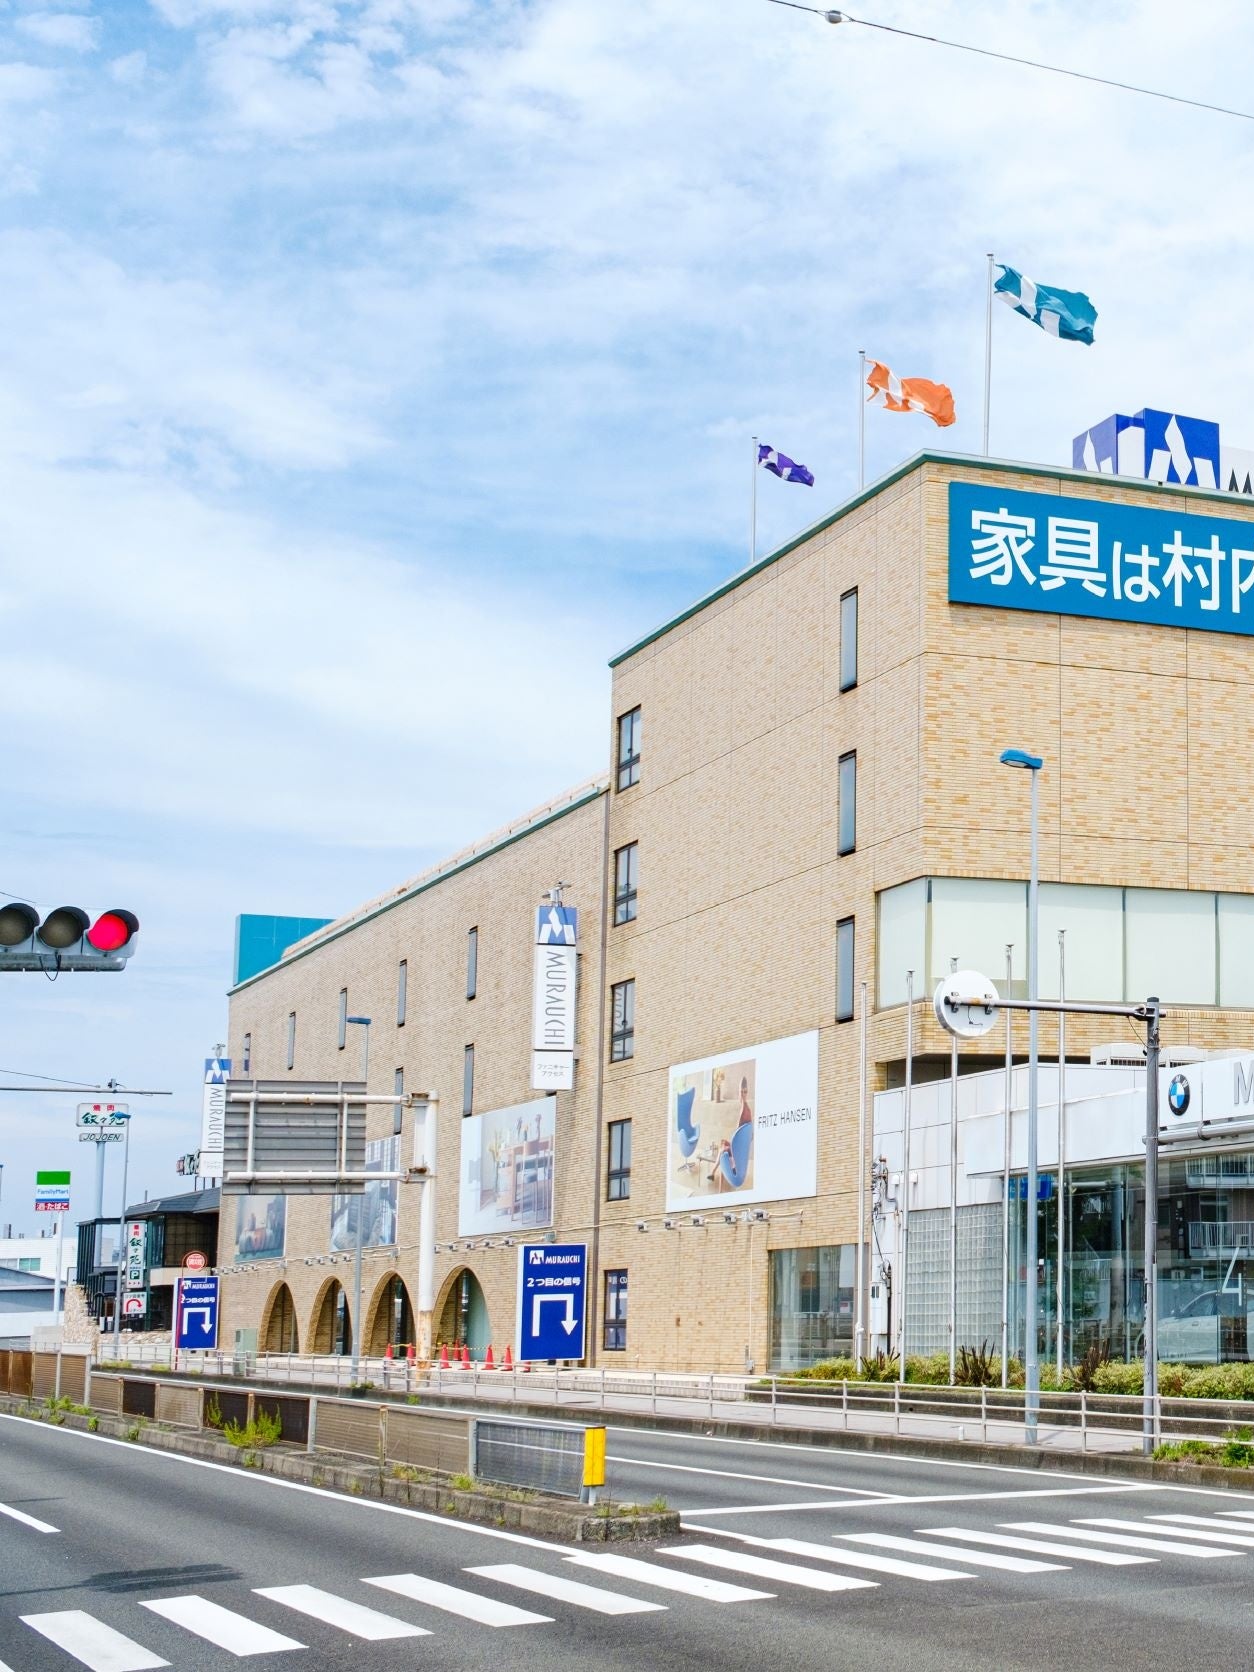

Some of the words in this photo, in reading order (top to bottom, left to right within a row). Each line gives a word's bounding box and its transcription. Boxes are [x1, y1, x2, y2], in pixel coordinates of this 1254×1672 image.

[544, 951, 567, 1045] MURAUCHI
[207, 1087, 224, 1149] MURAUCHI
[758, 1113, 778, 1129] FRITZ
[781, 1106, 812, 1125] HANSEN
[83, 1133, 121, 1141] JOJOEN
[545, 1254, 581, 1265] MURAUCHI
[526, 1276, 581, 1287] 2つ目の信号
